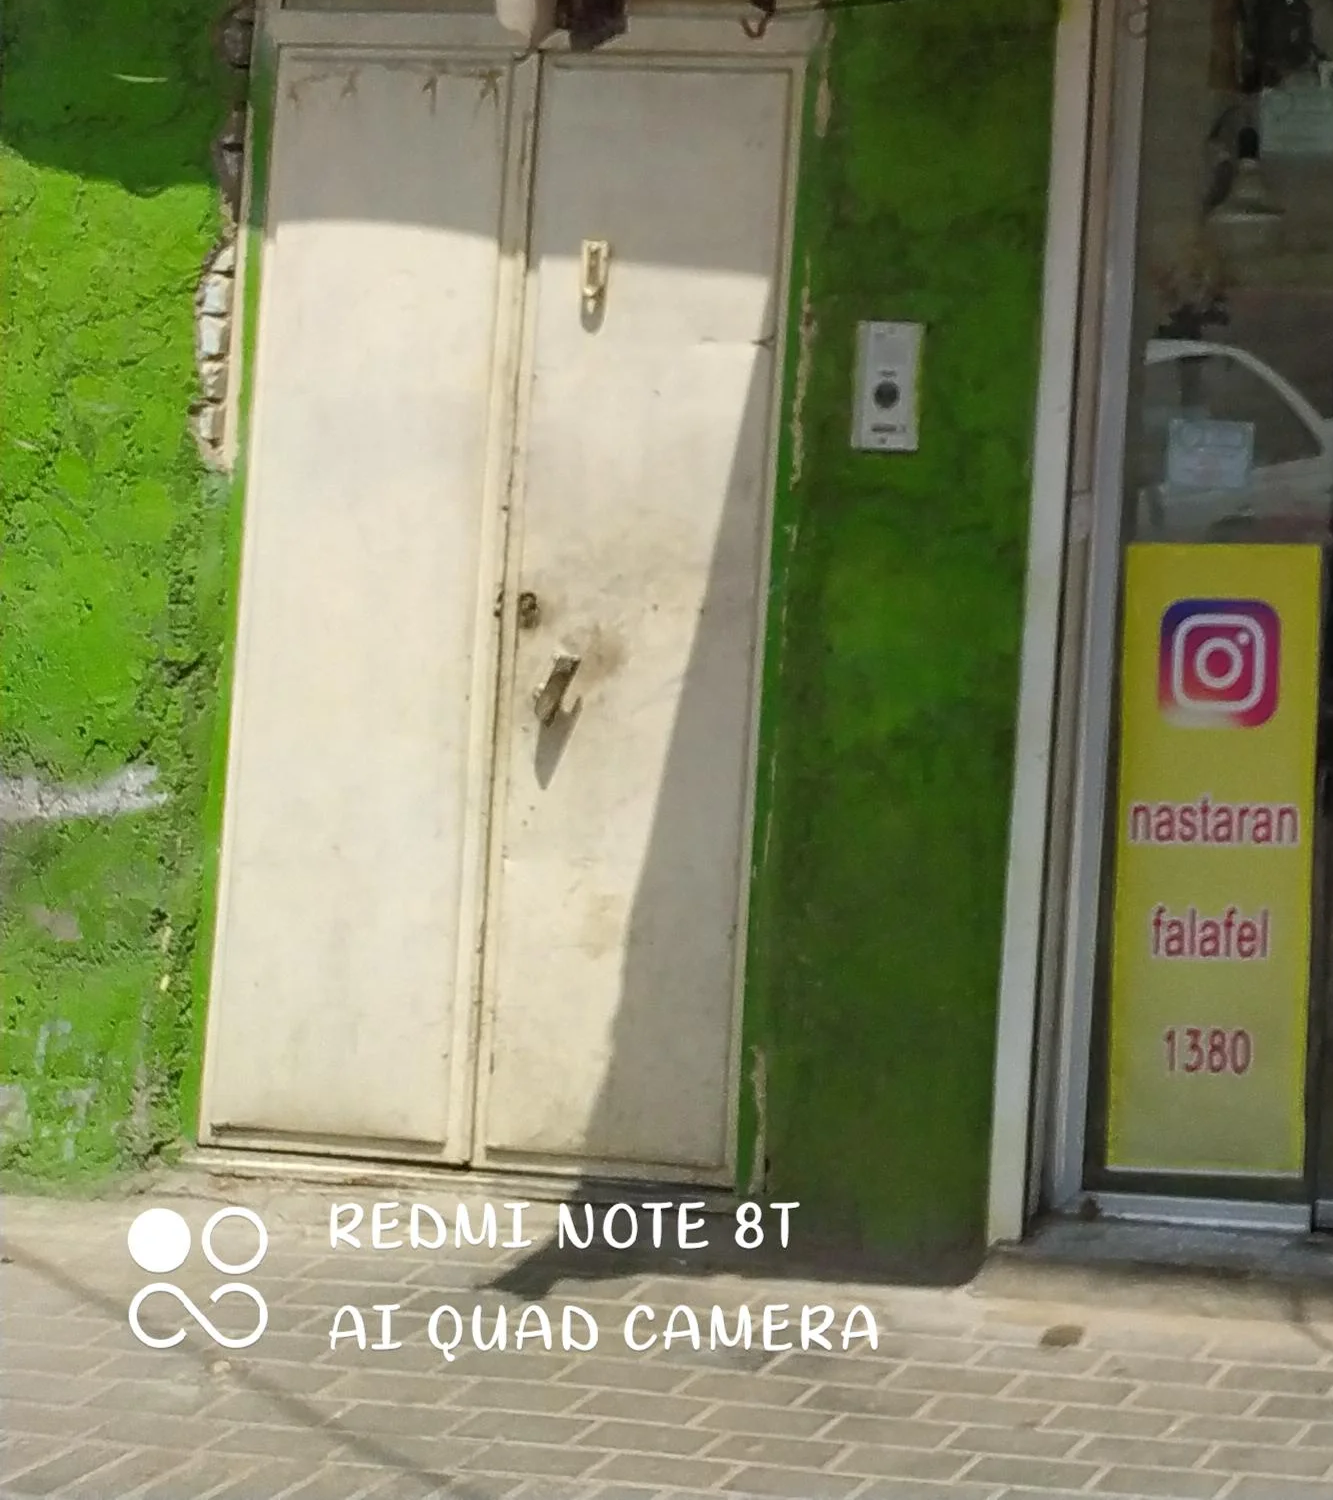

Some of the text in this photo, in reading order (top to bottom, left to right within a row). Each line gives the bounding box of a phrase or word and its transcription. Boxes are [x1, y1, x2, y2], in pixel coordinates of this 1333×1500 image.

[1130, 797, 1299, 846] nastaran
[1151, 907, 1270, 960] falafel
[1162, 1027, 1254, 1077] 1380
